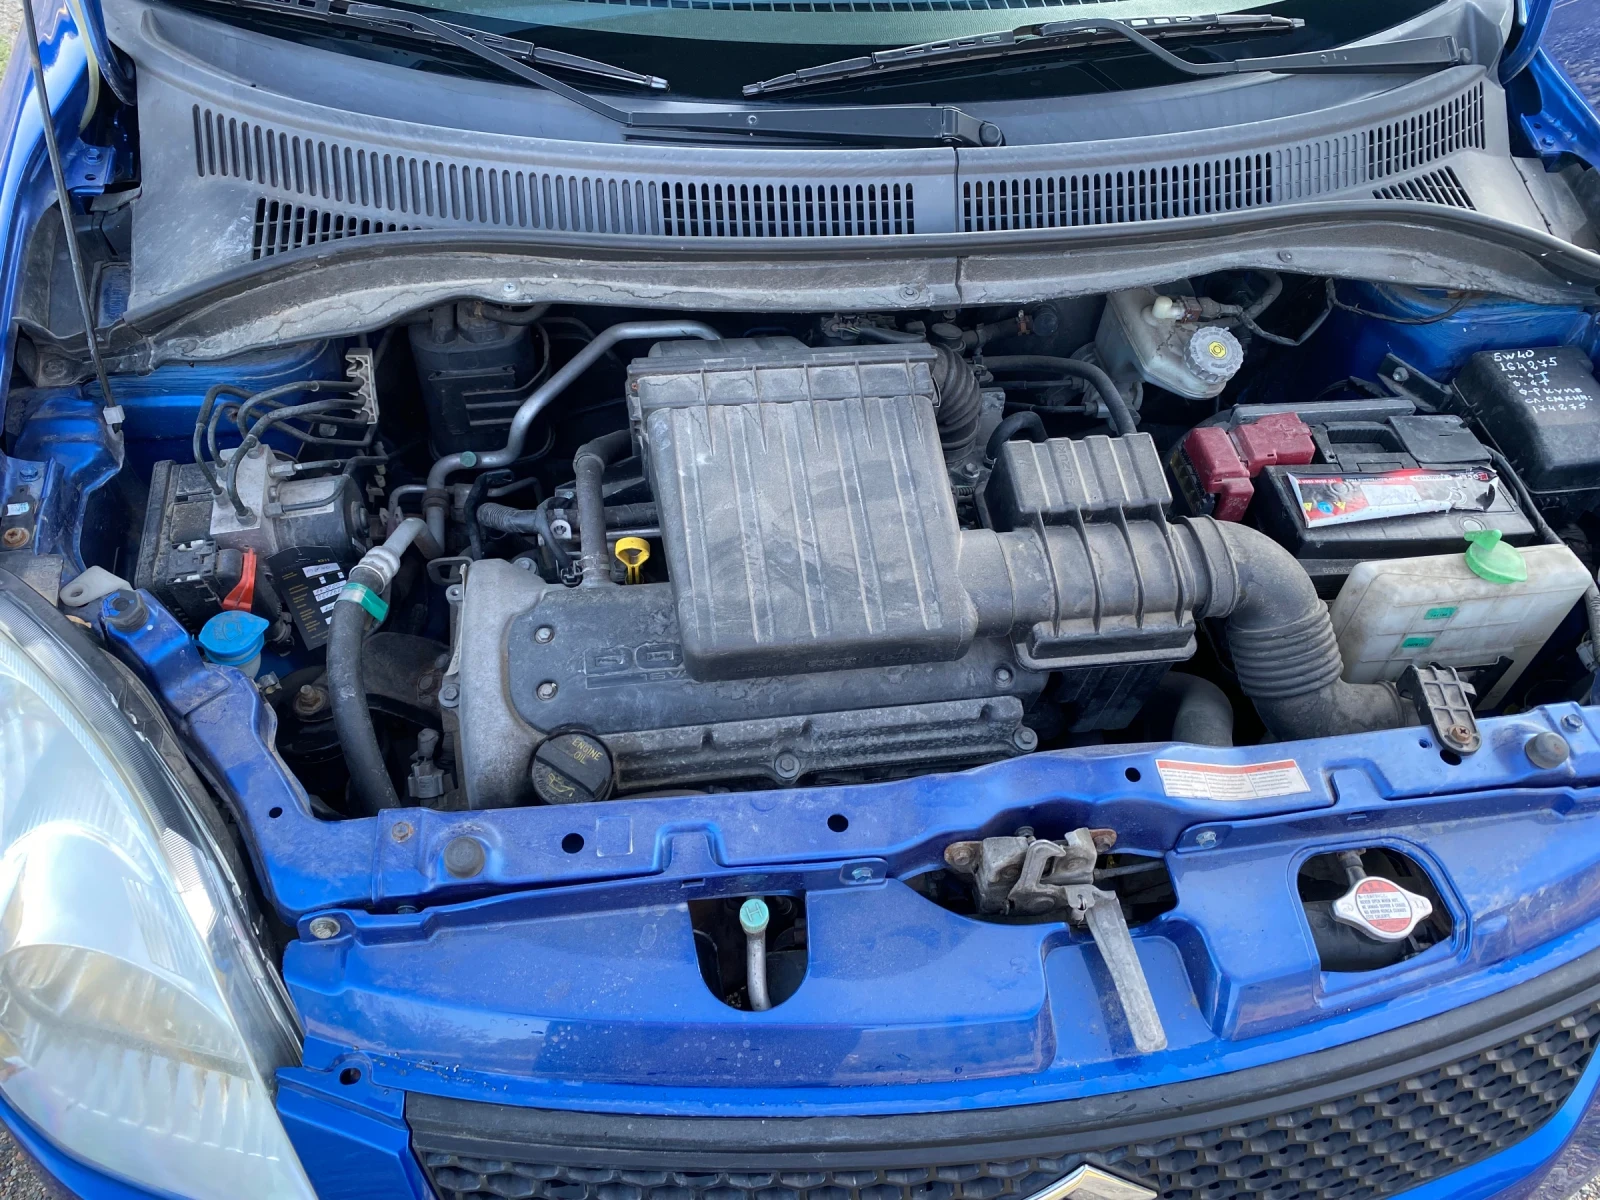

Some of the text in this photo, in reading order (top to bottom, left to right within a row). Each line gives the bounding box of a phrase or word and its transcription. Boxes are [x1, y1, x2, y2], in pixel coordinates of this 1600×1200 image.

[1500, 357, 1558, 372] 164275
[1532, 403, 1587, 414] 174275
[1055, 442, 1077, 487] SUZUKI
[571, 737, 604, 762] ENGINE
[573, 751, 586, 765] OIL
[745, 902, 763, 922] H
